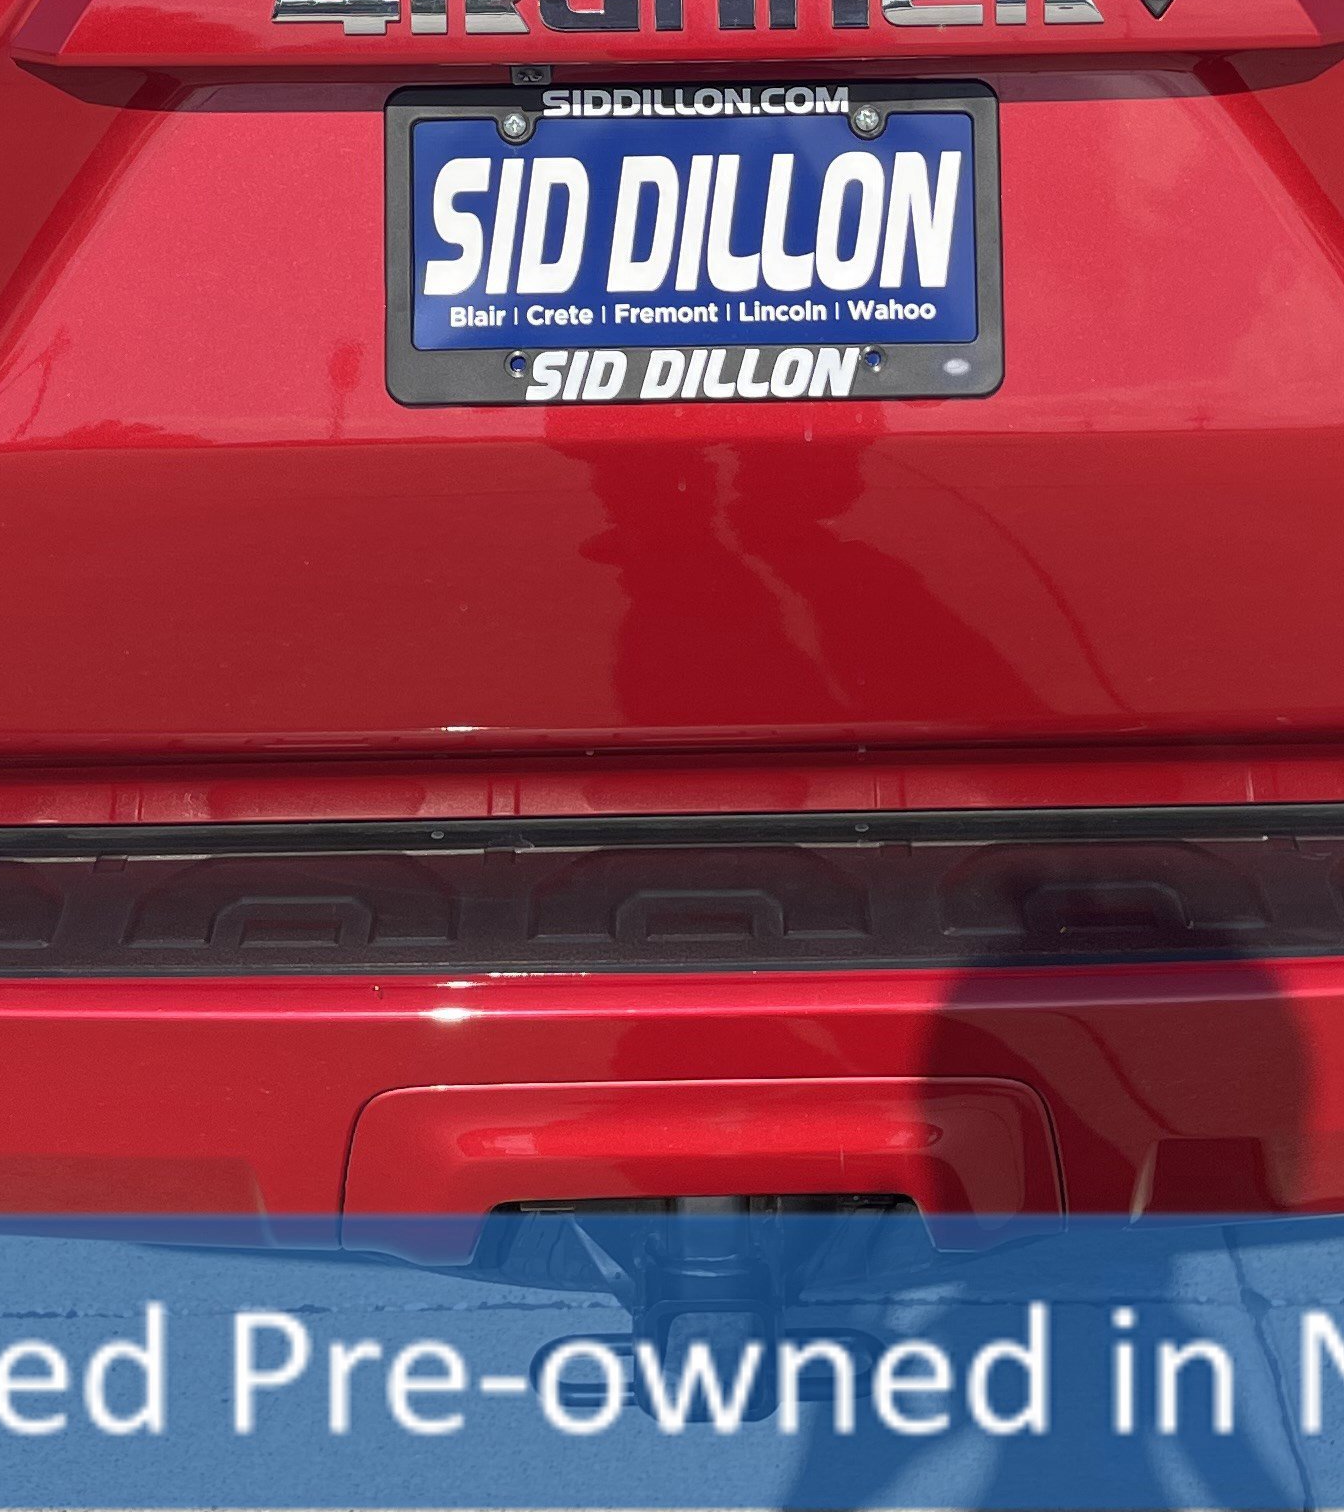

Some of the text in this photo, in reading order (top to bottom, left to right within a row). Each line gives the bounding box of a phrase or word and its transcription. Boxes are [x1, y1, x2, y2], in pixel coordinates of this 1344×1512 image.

[542, 86, 849, 116] SIDDILLON.COM
[423, 151, 961, 295] SID DILLON
[450, 298, 936, 327] Blair Crete Fremont Lincoln Wahoo
[526, 347, 860, 401] SID DILLON
